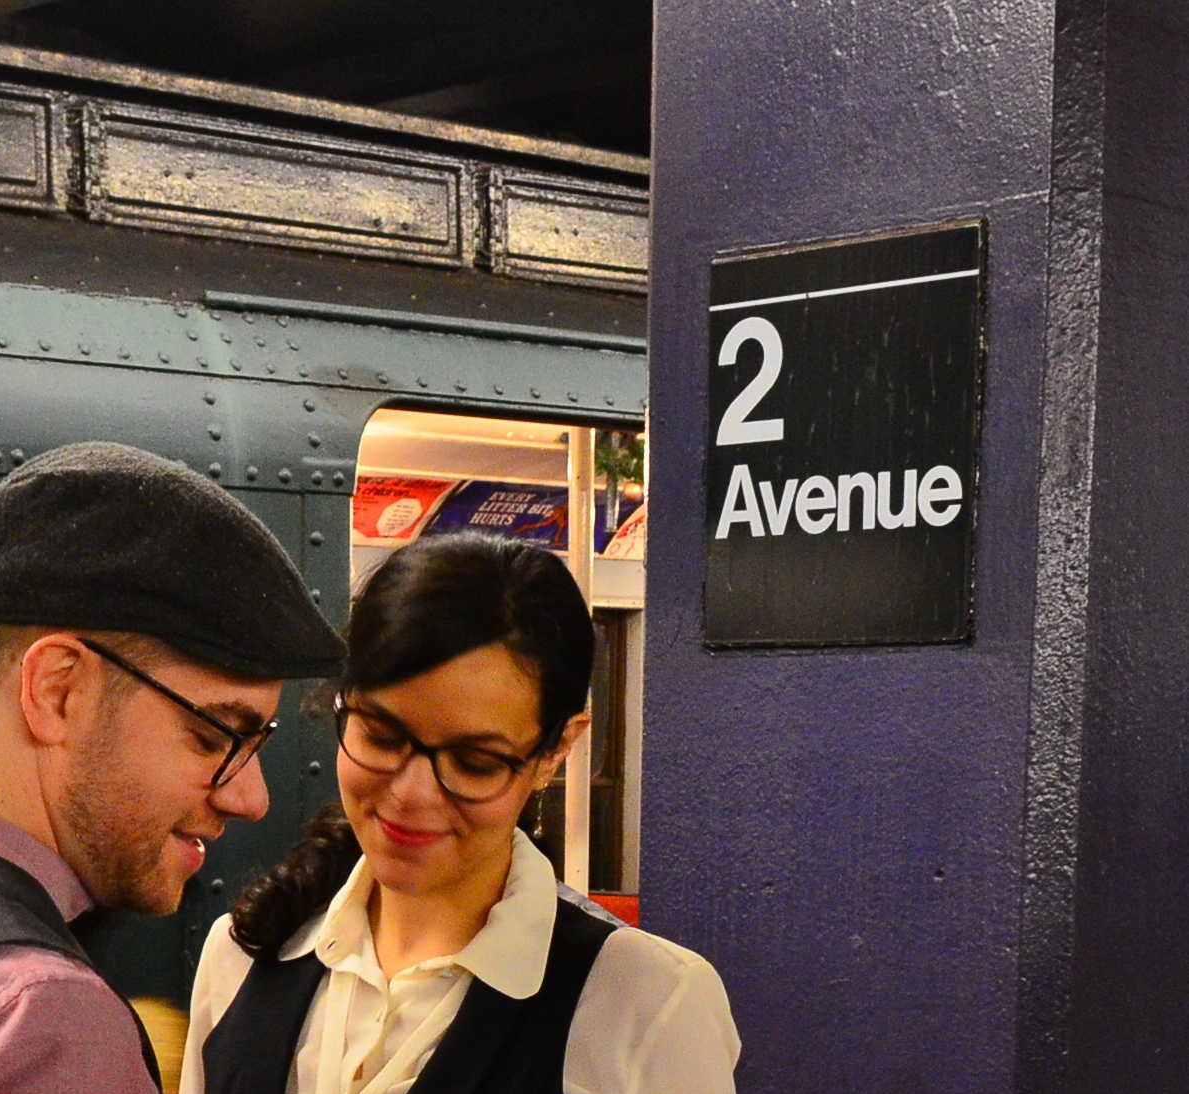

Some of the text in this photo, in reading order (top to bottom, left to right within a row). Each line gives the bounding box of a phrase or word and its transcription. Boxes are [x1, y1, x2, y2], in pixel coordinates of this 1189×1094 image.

[716, 316, 784, 446] 2
[489, 491, 536, 502] EVERY
[715, 464, 963, 540] Avenue
[478, 501, 528, 514] LITTER
[470, 512, 517, 525] HURTS
